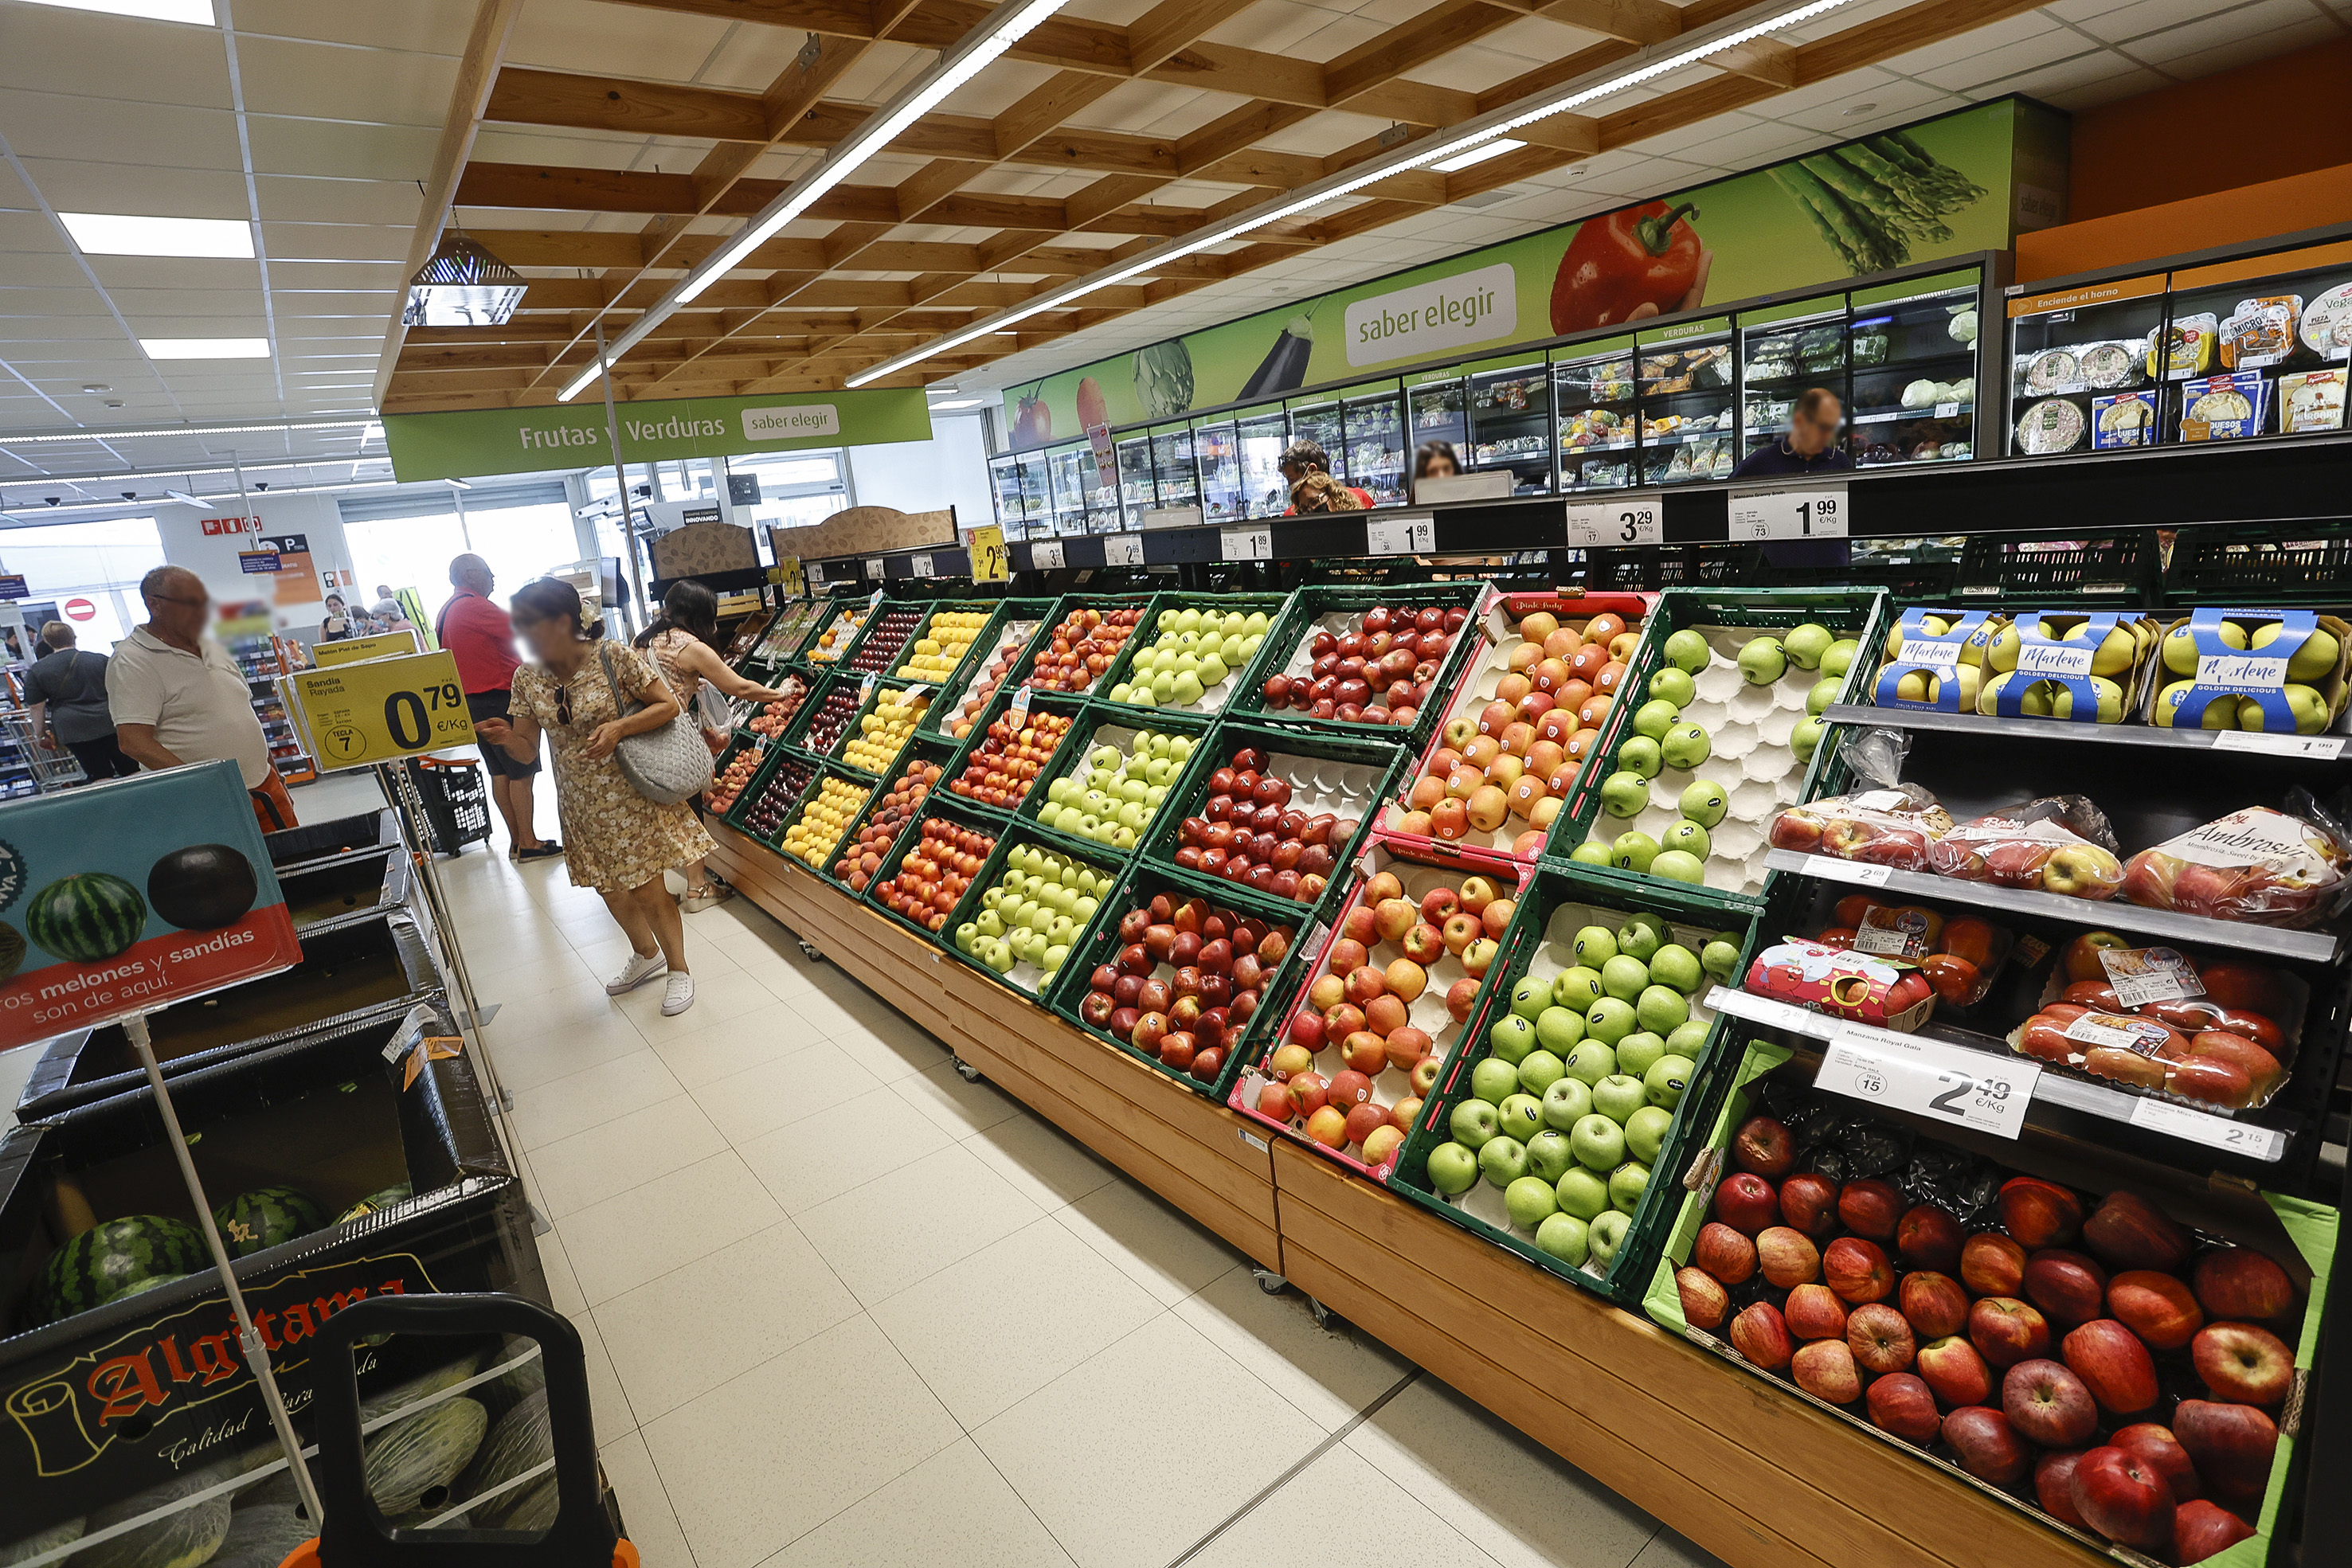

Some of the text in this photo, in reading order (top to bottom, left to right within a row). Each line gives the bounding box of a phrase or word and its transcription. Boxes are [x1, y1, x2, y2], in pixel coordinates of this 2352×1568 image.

[2037, 288, 2119, 308] Enciende el horno
[1359, 287, 1495, 343] saber elegir
[1663, 323, 1704, 338] VERDURAS
[2234, 316, 2264, 334] MICRO
[1421, 371, 1450, 381] VERDURAS
[751, 412, 828, 430] saber elegir
[2210, 420, 2241, 429] QUESOS
[519, 424, 597, 449] Frutas
[626, 416, 726, 441] Verduras
[685, 514, 718, 524] INNOVANDO
[1796, 499, 1837, 534] 1 99
[1619, 510, 1653, 542] 3 29
[1755, 528, 1767, 537] 73
[1250, 534, 1267, 557] 1 89
[1405, 524, 1428, 550] 1 99
[987, 545, 999, 579] 2
[1049, 549, 1057, 566] 3
[1125, 545, 1134, 563] 2
[1516, 600, 1539, 610] Pink
[1904, 642, 1955, 661] Marlene
[2024, 647, 2084, 669] Marlene
[2047, 672, 2084, 681] DELICIOUS
[309, 685, 346, 698] Rayada
[385, 682, 462, 749] 0 79
[332, 729, 354, 737] TECLA
[436, 718, 468, 732] €/Kg
[339, 737, 350, 752] 7
[2301, 741, 2312, 751] 1
[1982, 816, 2025, 830] Baby
[1858, 869, 1873, 880] 2
[40, 959, 145, 999] melones
[150, 956, 162, 971] y
[170, 930, 255, 964] sandías
[33, 971, 174, 1024] son de aquí.
[1782, 1009, 1790, 1021] 2
[1845, 1029, 1922, 1052] Manzana Royal Gala
[1863, 1079, 1880, 1092] 15
[1928, 1070, 2012, 1116] 2 49
[1975, 1097, 2005, 1114] €/Kg
[2225, 1128, 2263, 1144] 2 15
[158, 1407, 253, 1471] Calidad
